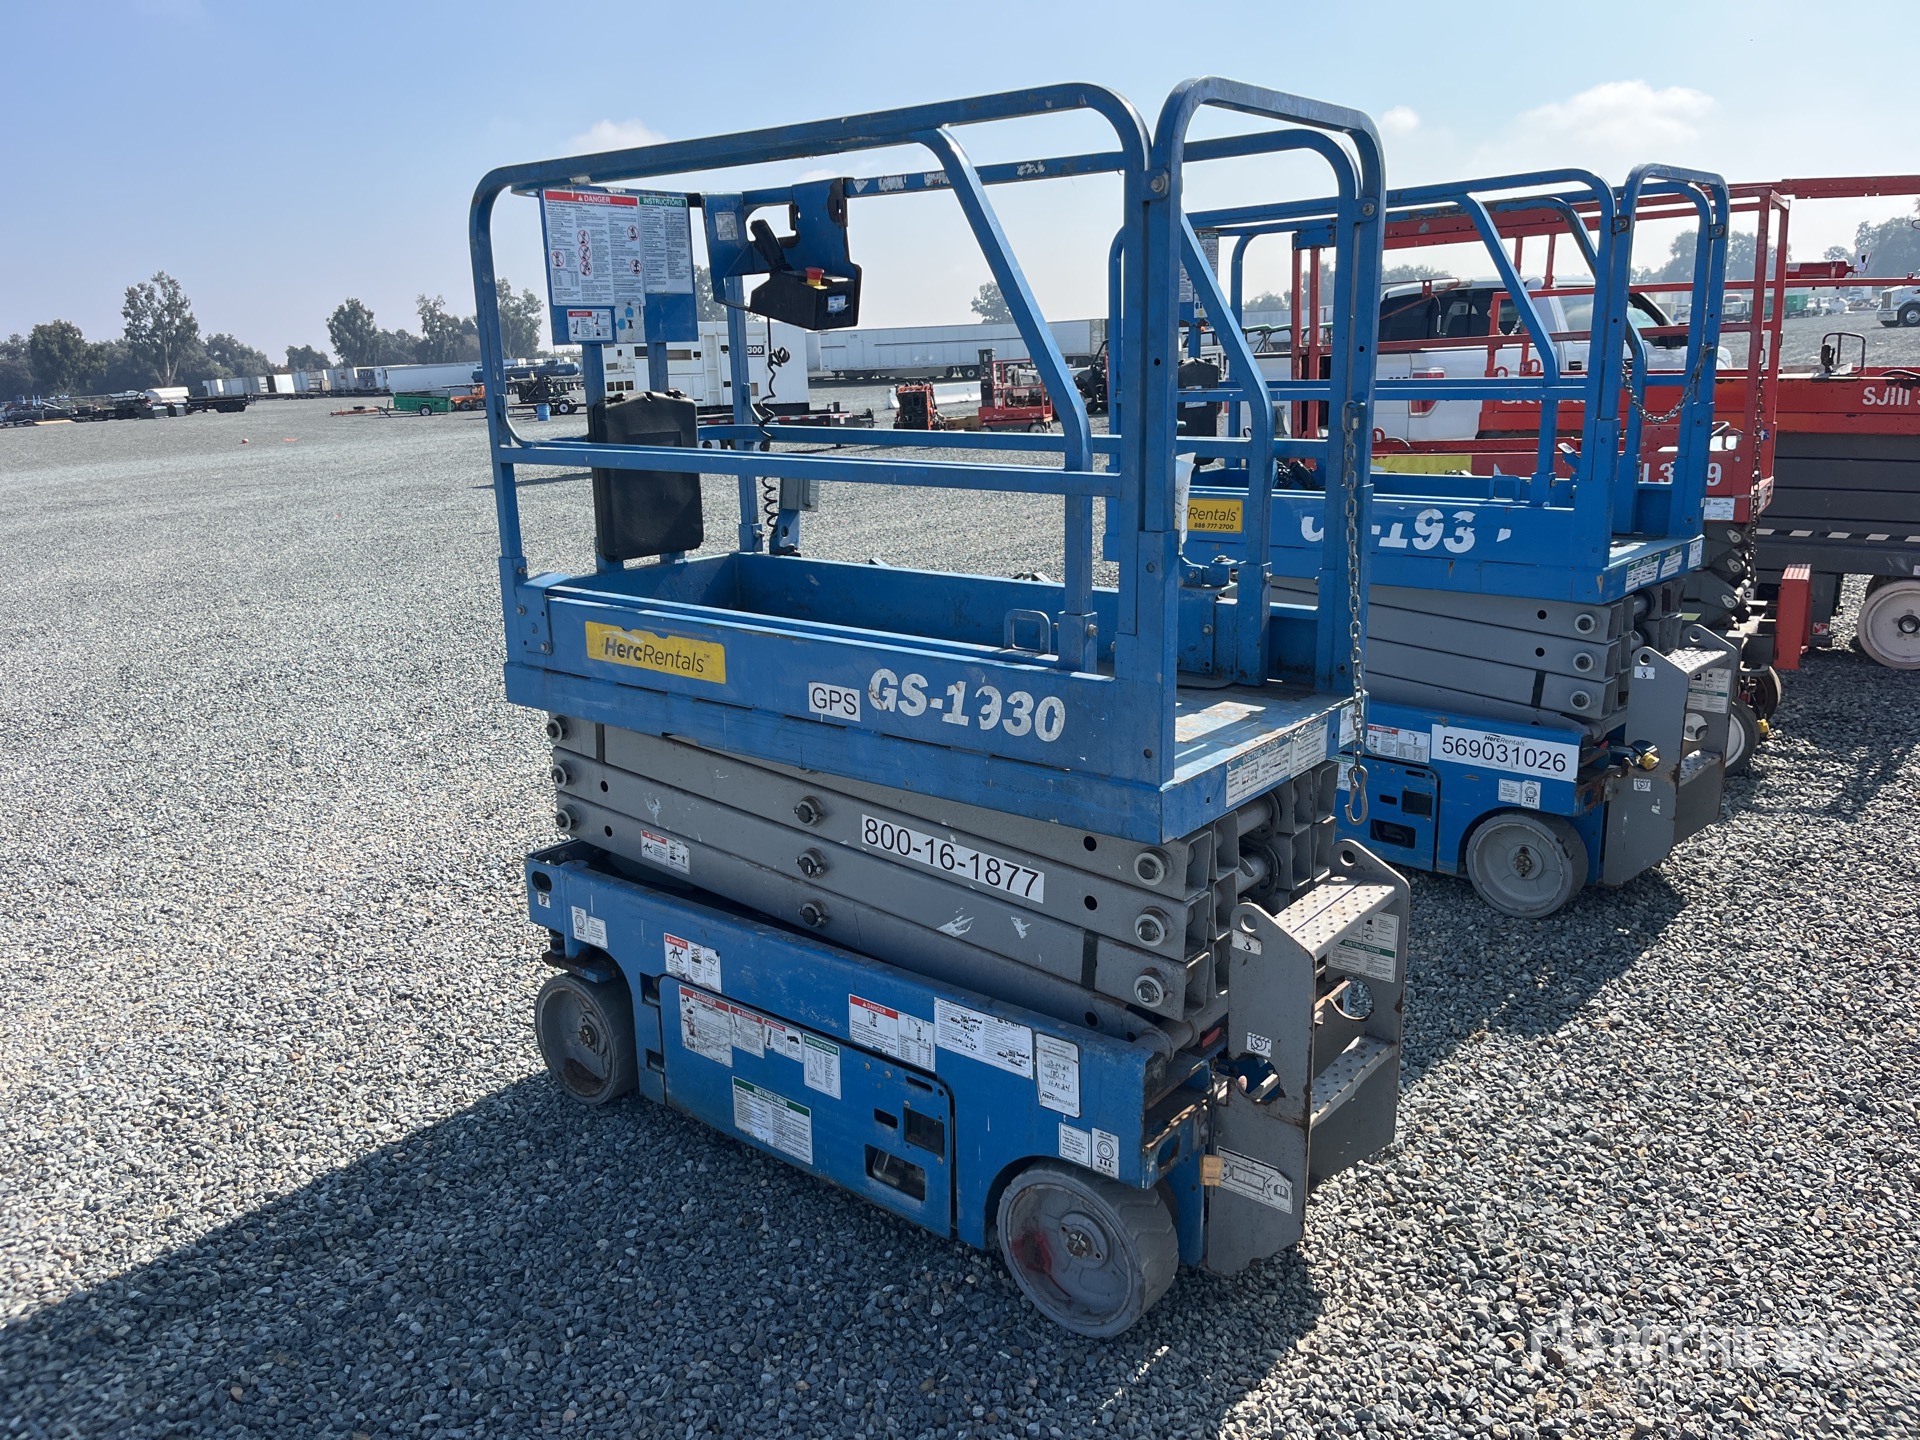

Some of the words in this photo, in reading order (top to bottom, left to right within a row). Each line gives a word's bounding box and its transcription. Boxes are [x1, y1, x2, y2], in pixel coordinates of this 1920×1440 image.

[584, 196, 611, 204] DANGER
[747, 346, 763, 354] 300
[811, 687, 858, 716] GPS
[1442, 735, 1567, 773] 569031026
[864, 818, 1039, 897] 800-16-1877
[671, 936, 687, 947] DANGER
[1344, 941, 1381, 954] INSTRUCTIONS
[697, 993, 717, 1006] DANGER
[741, 1010, 758, 1021] DANGER
[867, 1003, 887, 1015] DANGER
[805, 1037, 837, 1054] INSTRUCTIONS
